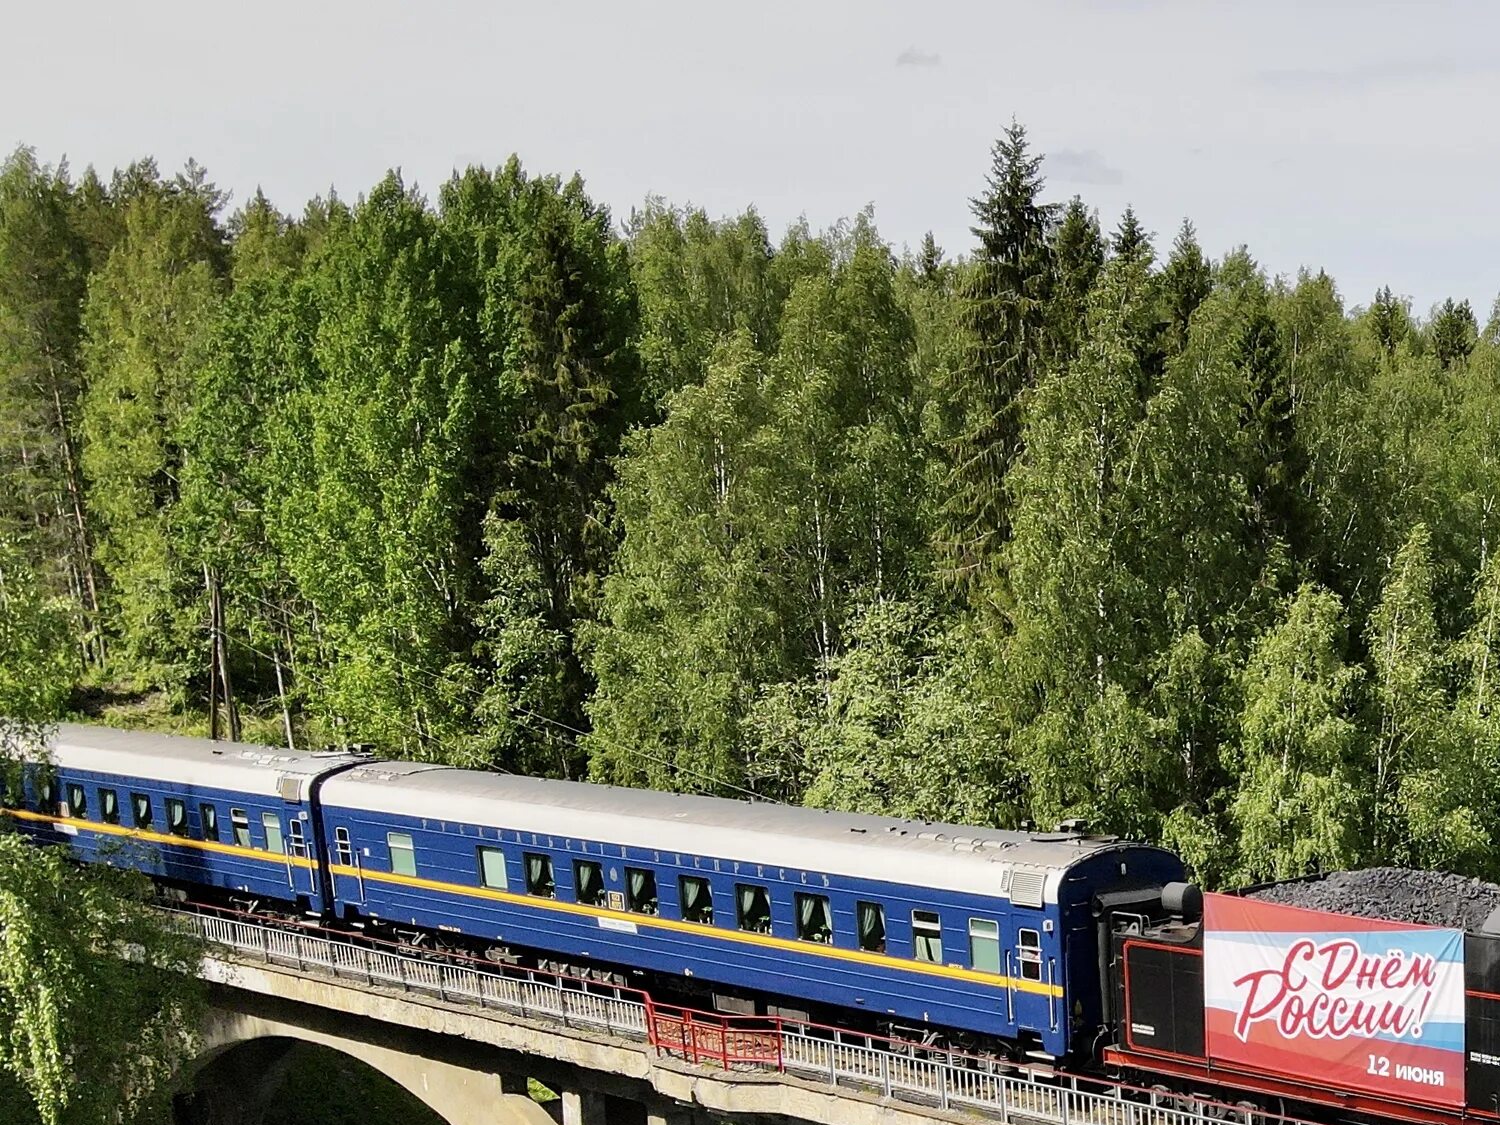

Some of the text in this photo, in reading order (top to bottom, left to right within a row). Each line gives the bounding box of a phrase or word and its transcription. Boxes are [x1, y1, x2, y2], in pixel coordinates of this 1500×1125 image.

[1282, 940, 1436, 992] С Днём
[1233, 969, 1431, 1038] России!
[1367, 1054, 1389, 1077] 12
